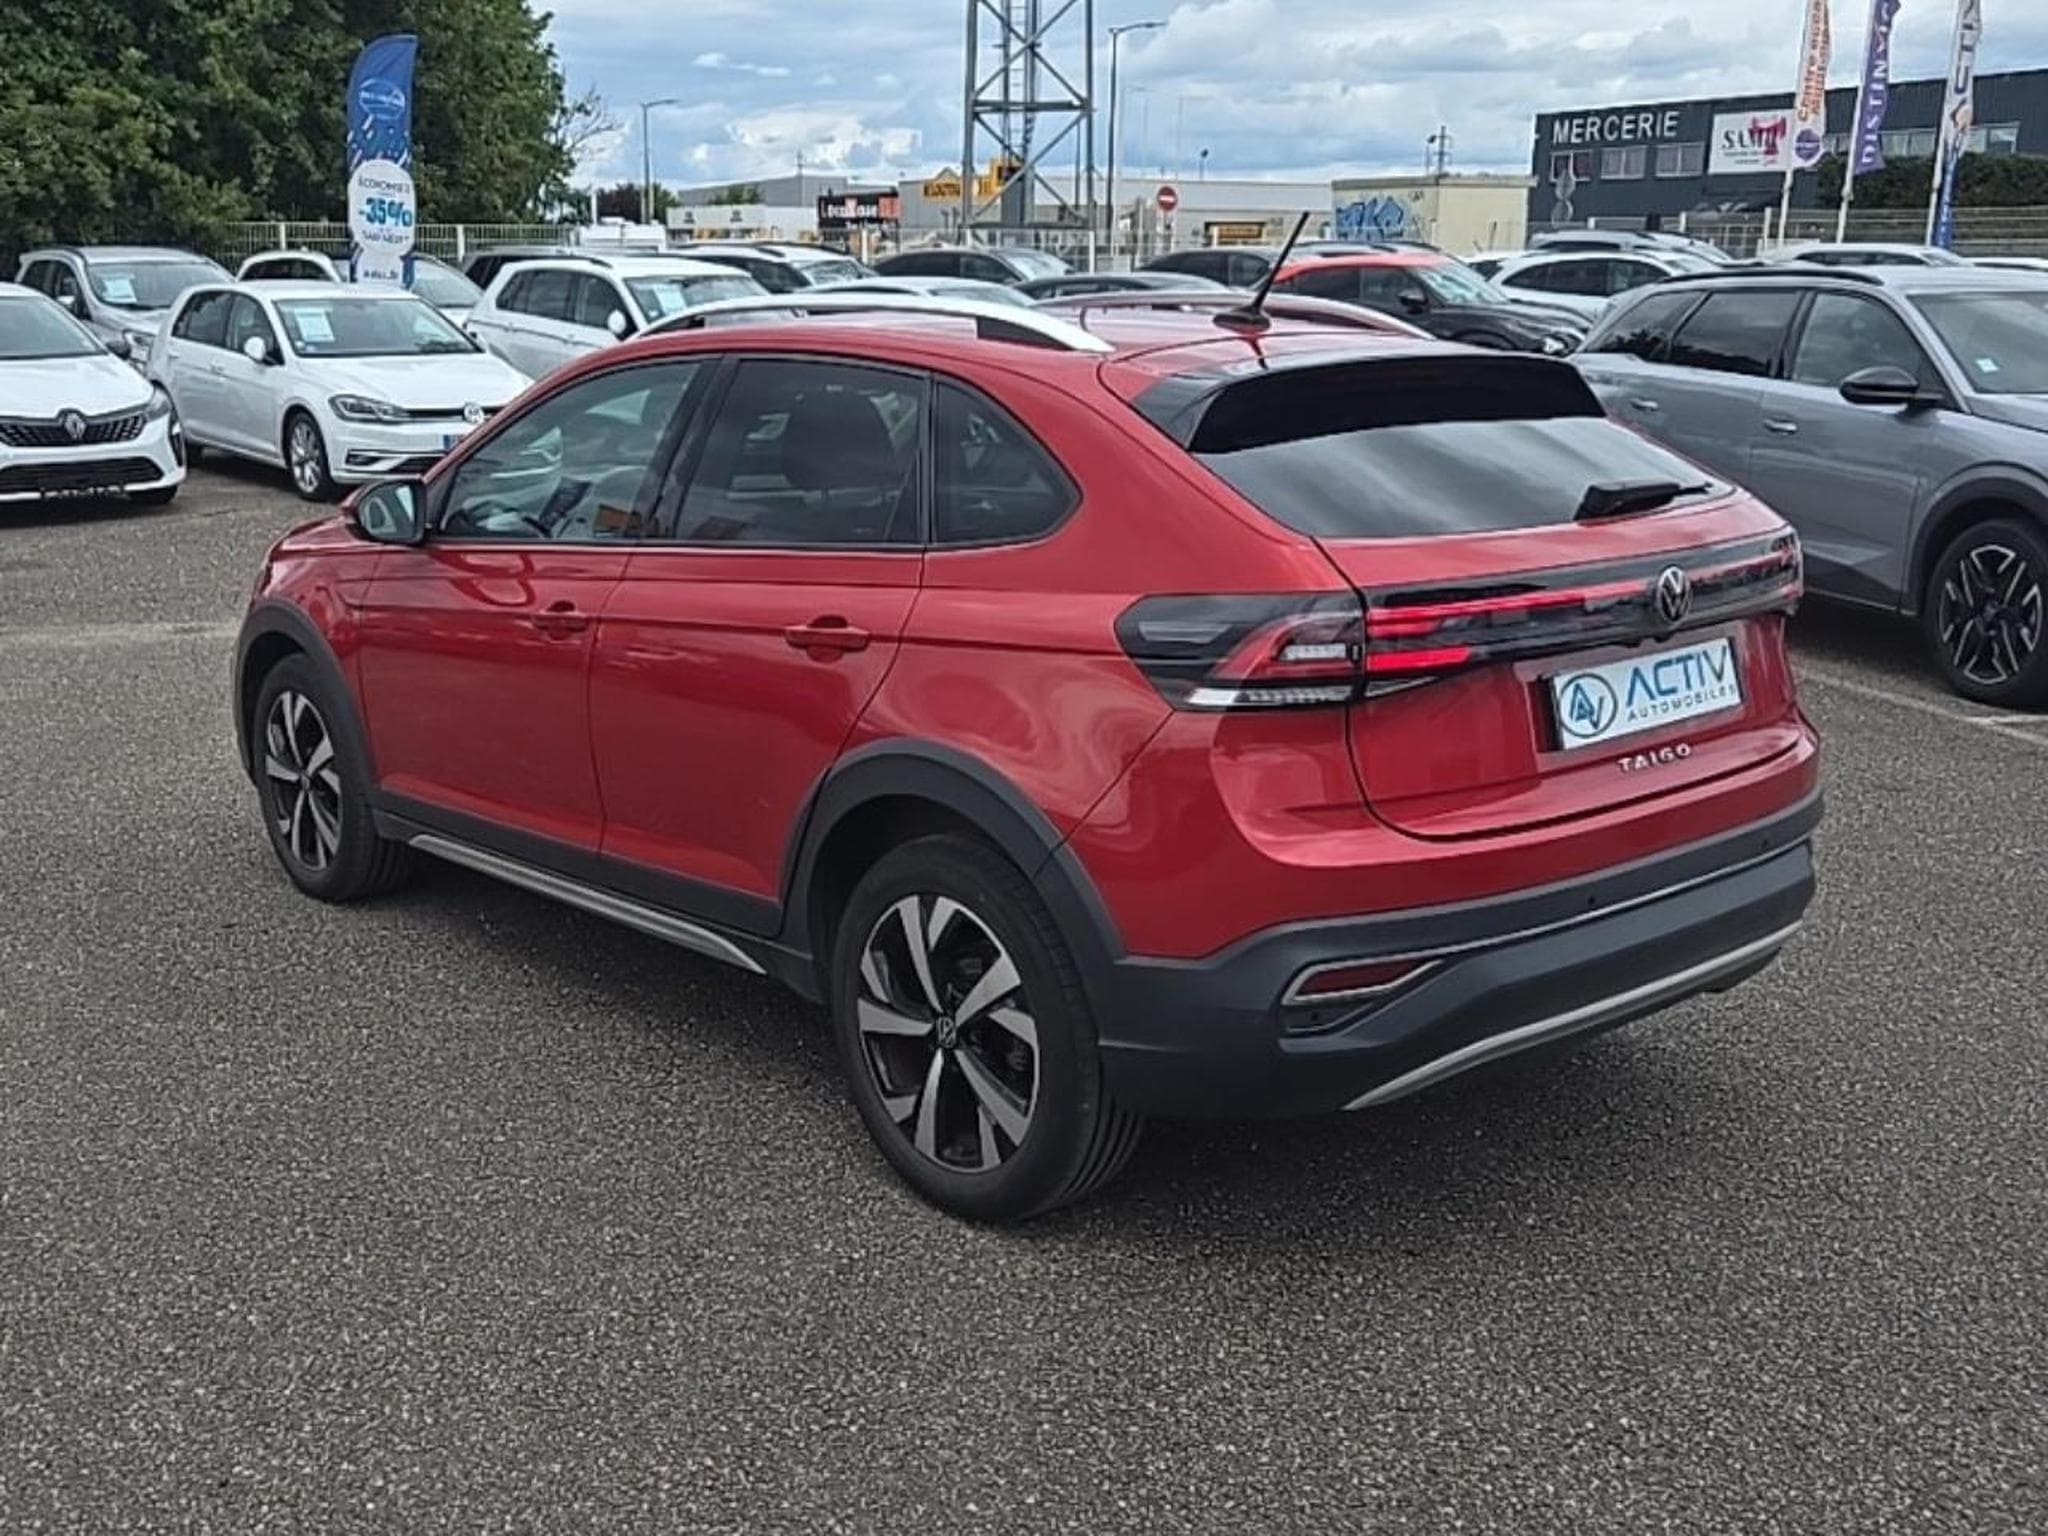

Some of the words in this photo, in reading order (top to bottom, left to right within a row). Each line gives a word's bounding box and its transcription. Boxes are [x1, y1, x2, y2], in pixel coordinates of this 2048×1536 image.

[1552, 111, 1680, 145] MERCERIE
[359, 197, 412, 227] -35%
[1626, 645, 1728, 707] ACTIV
[1627, 683, 1737, 723] AUTOMOBILES
[1617, 743, 1692, 773] TAIGO
